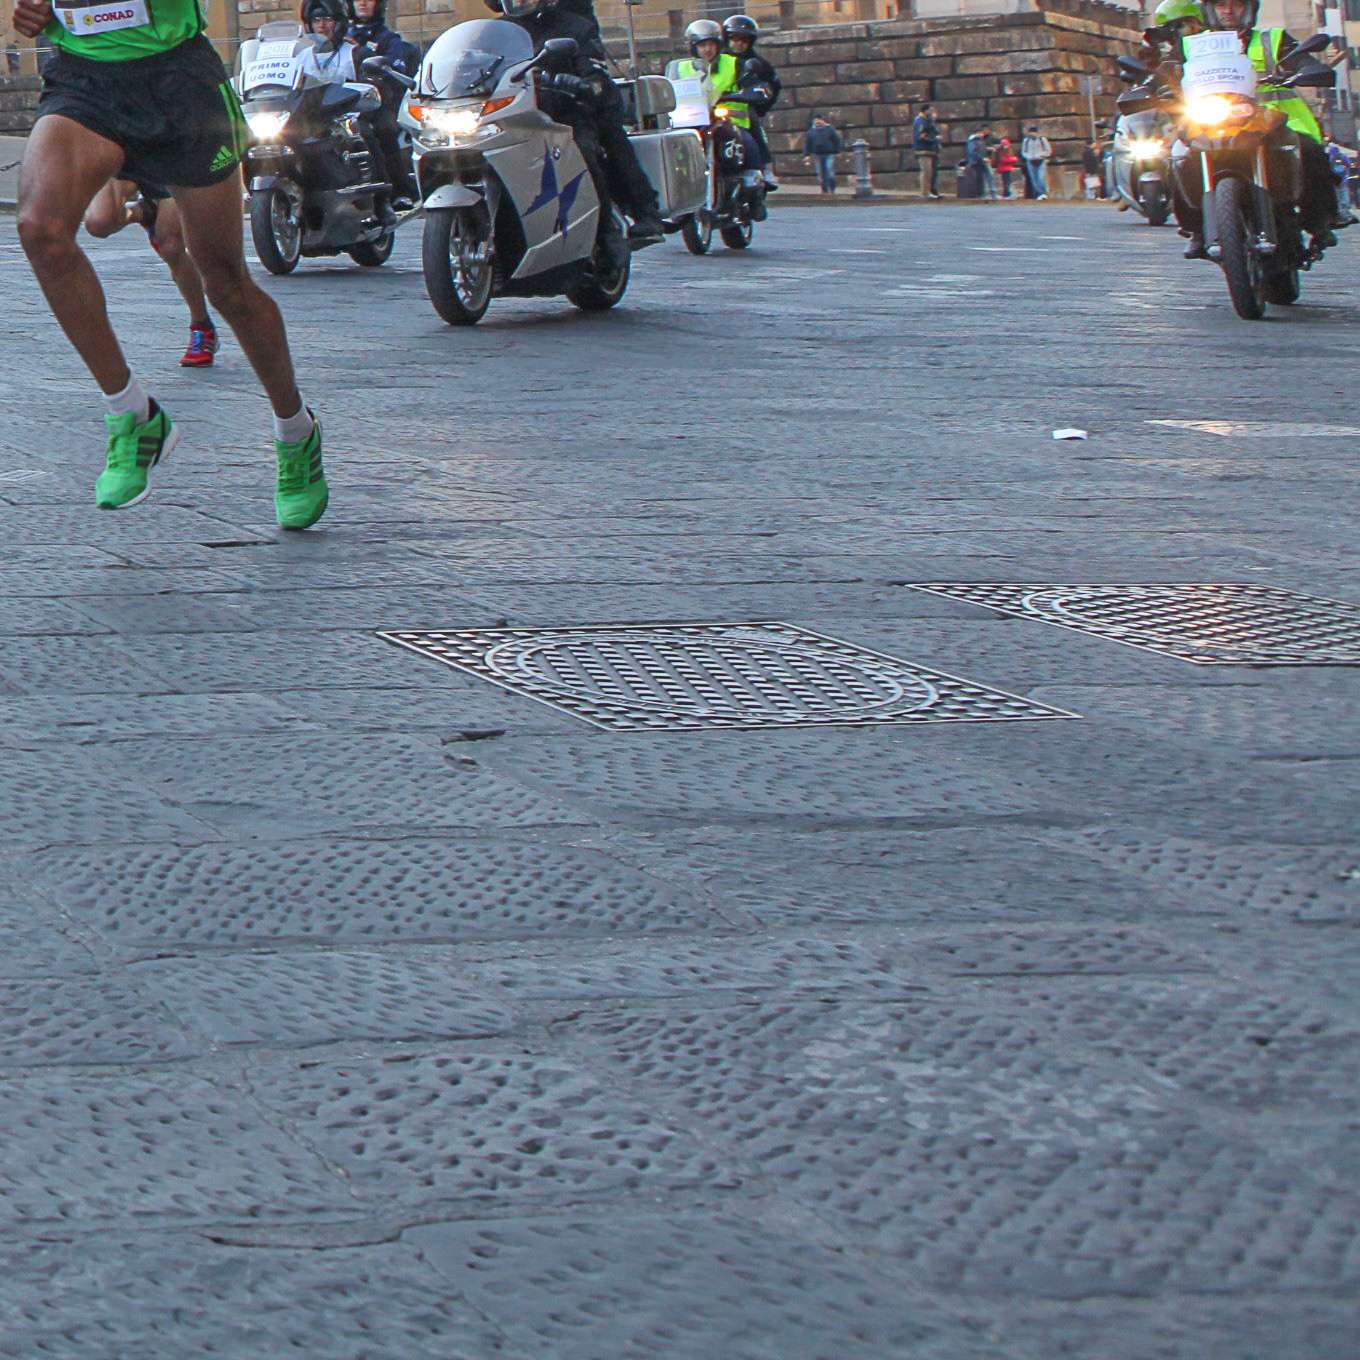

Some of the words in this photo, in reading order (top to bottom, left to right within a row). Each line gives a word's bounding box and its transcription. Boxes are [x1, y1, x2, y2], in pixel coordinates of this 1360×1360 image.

[94, 9, 134, 23] CONAD
[250, 61, 290, 73] PRIMO
[250, 72, 286, 81] UOMO
